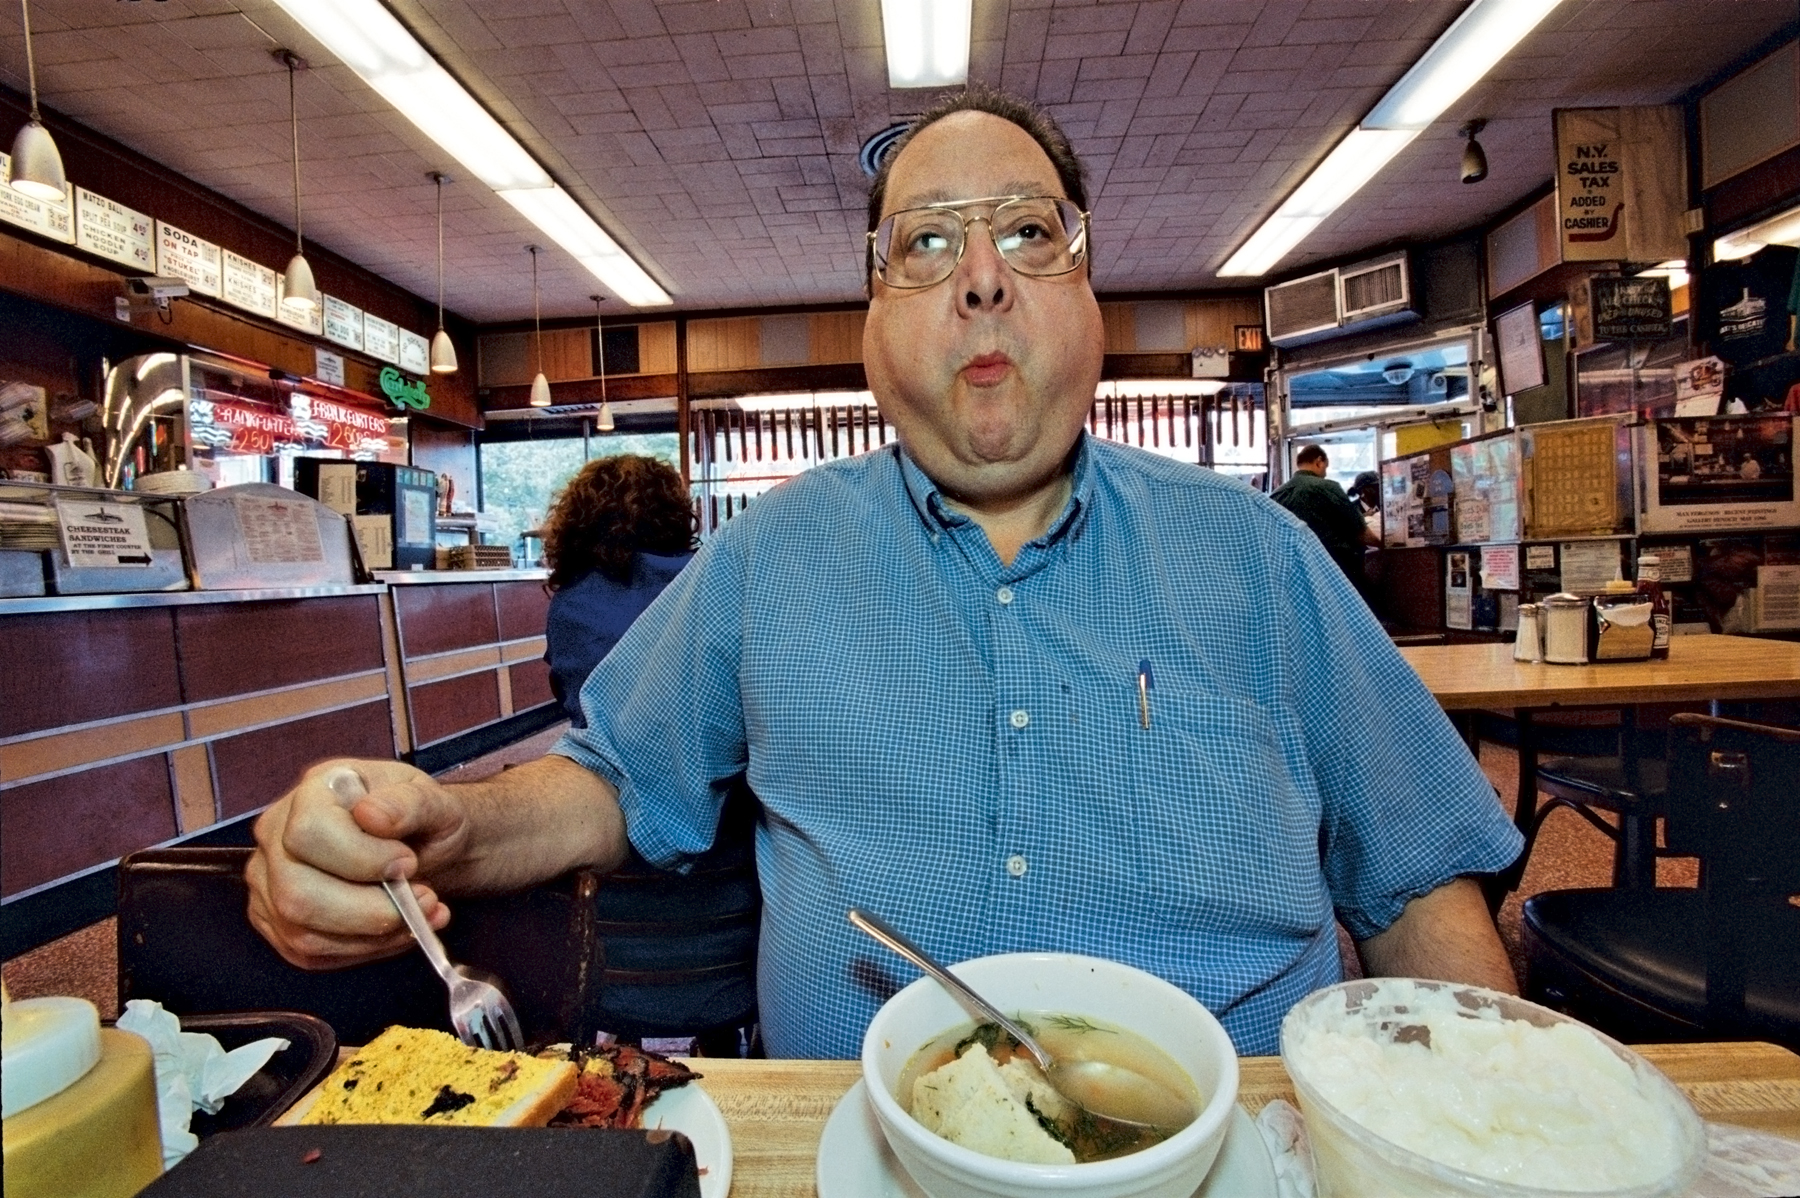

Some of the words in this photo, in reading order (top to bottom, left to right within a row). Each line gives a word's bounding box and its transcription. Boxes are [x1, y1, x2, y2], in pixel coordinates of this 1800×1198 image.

[1576, 144, 1608, 159] N.Y.
[1567, 161, 1619, 175] SALES
[1579, 176, 1610, 188] TAX
[83, 192, 106, 208] MATZO
[107, 202, 124, 216] BALL
[1570, 196, 1606, 207] ADDED
[1564, 217, 1609, 229] CASHIER
[83, 223, 126, 245] CHICKEN
[163, 226, 199, 249] SODA
[86, 232, 125, 252] NOODLE
[93, 242, 120, 255] SOUP
[163, 238, 178, 250] ON
[181, 246, 199, 258] TAP
[228, 253, 257, 272] KNISHES
[1238, 328, 1262, 350] EXIT
[67, 525, 131, 535] CHEESESTEAK
[68, 534, 127, 543] SANDWICHES
